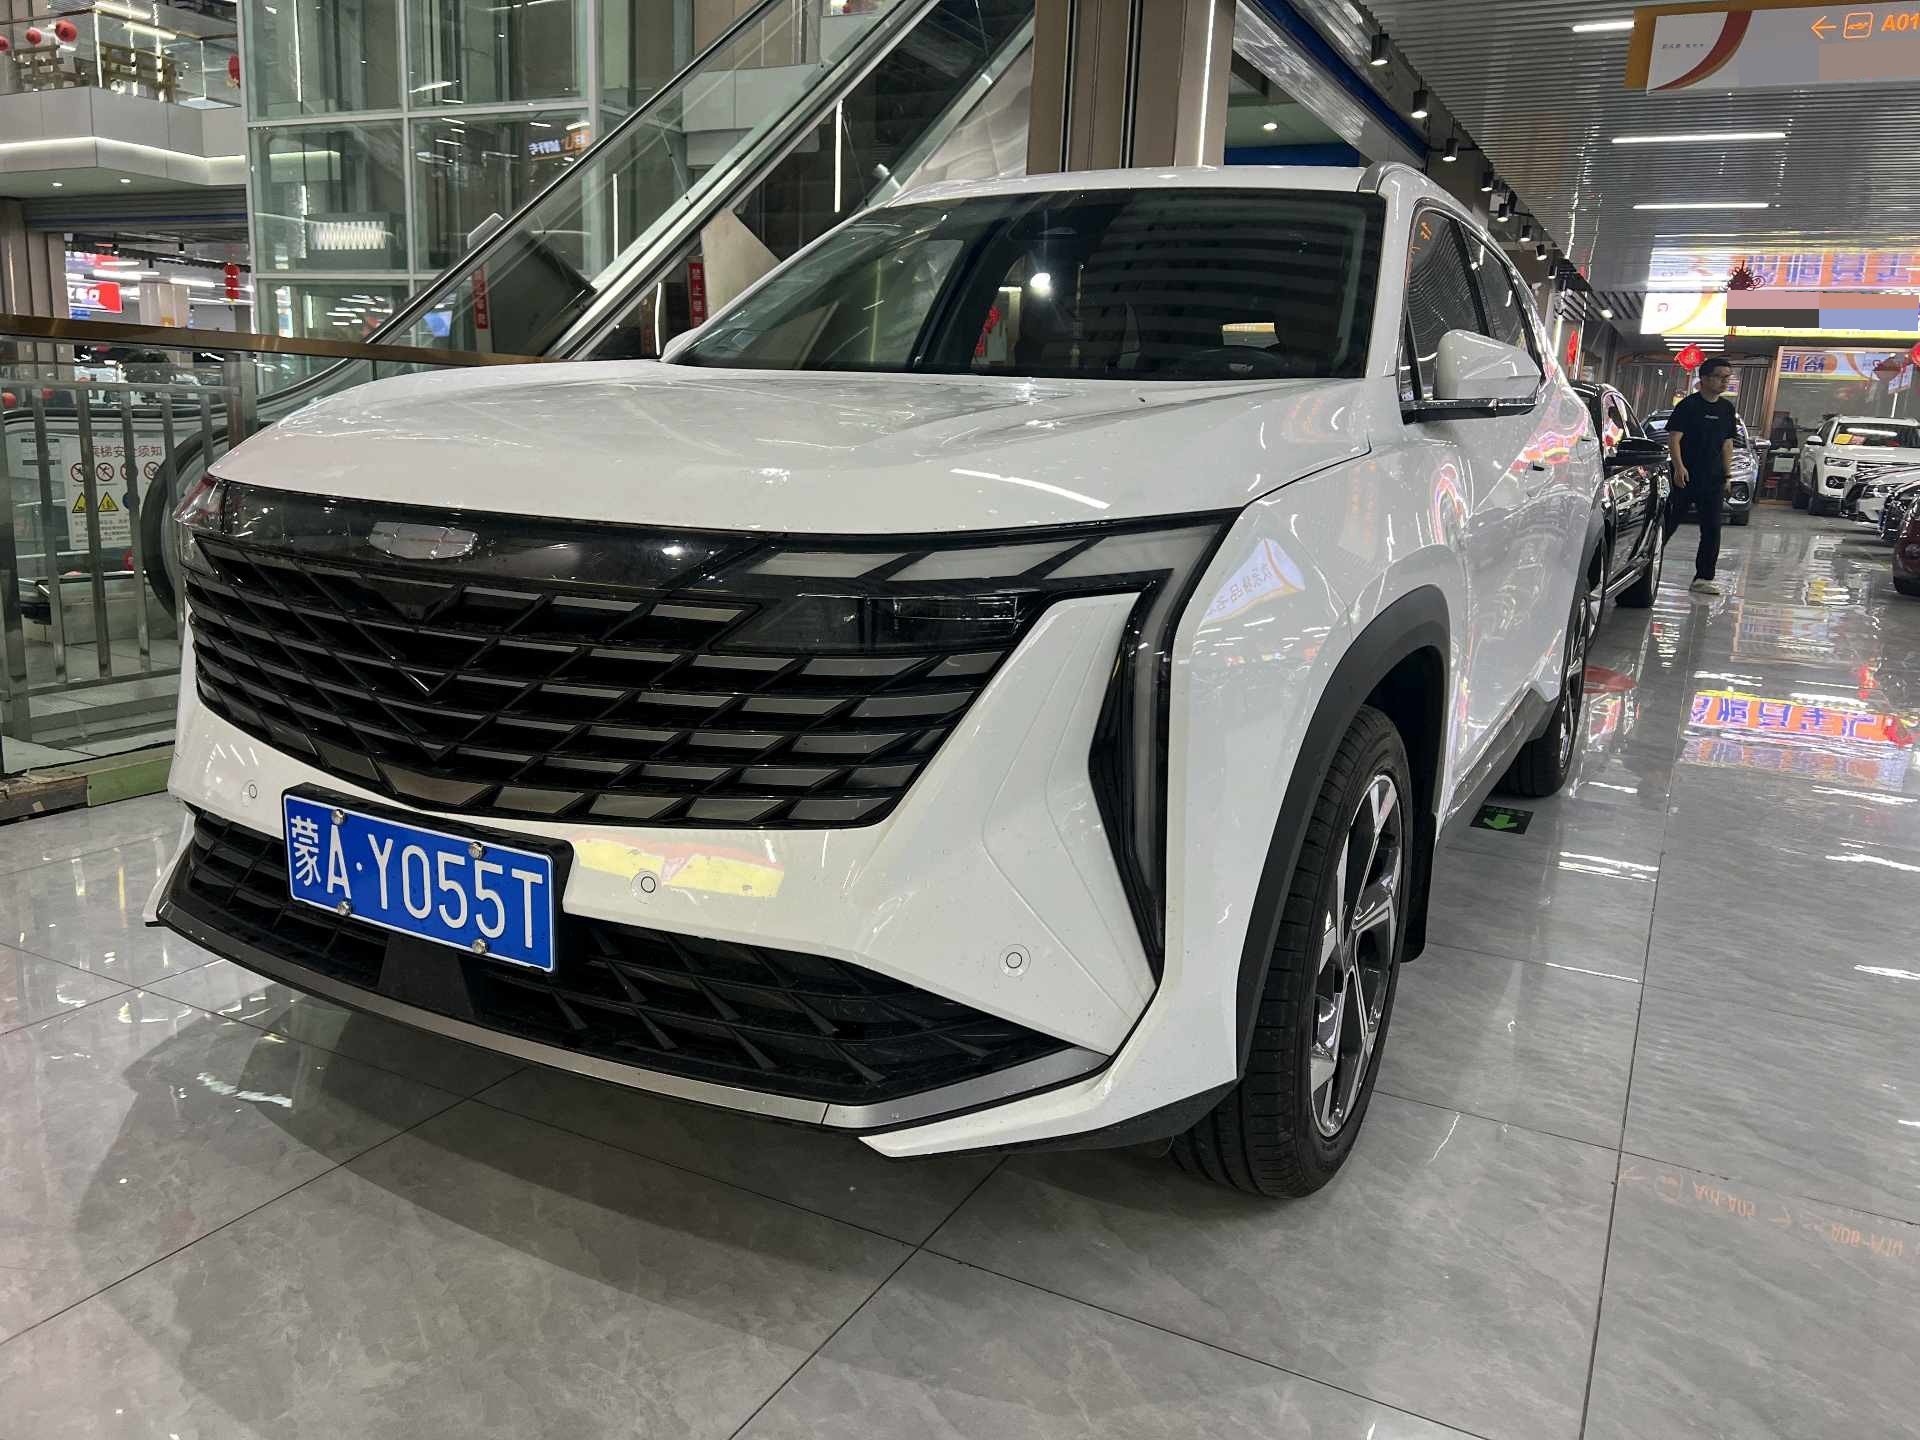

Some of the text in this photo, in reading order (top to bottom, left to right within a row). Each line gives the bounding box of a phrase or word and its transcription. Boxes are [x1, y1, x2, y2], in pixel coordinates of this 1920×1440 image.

[90, 445, 163, 458] 乘梯安须知
